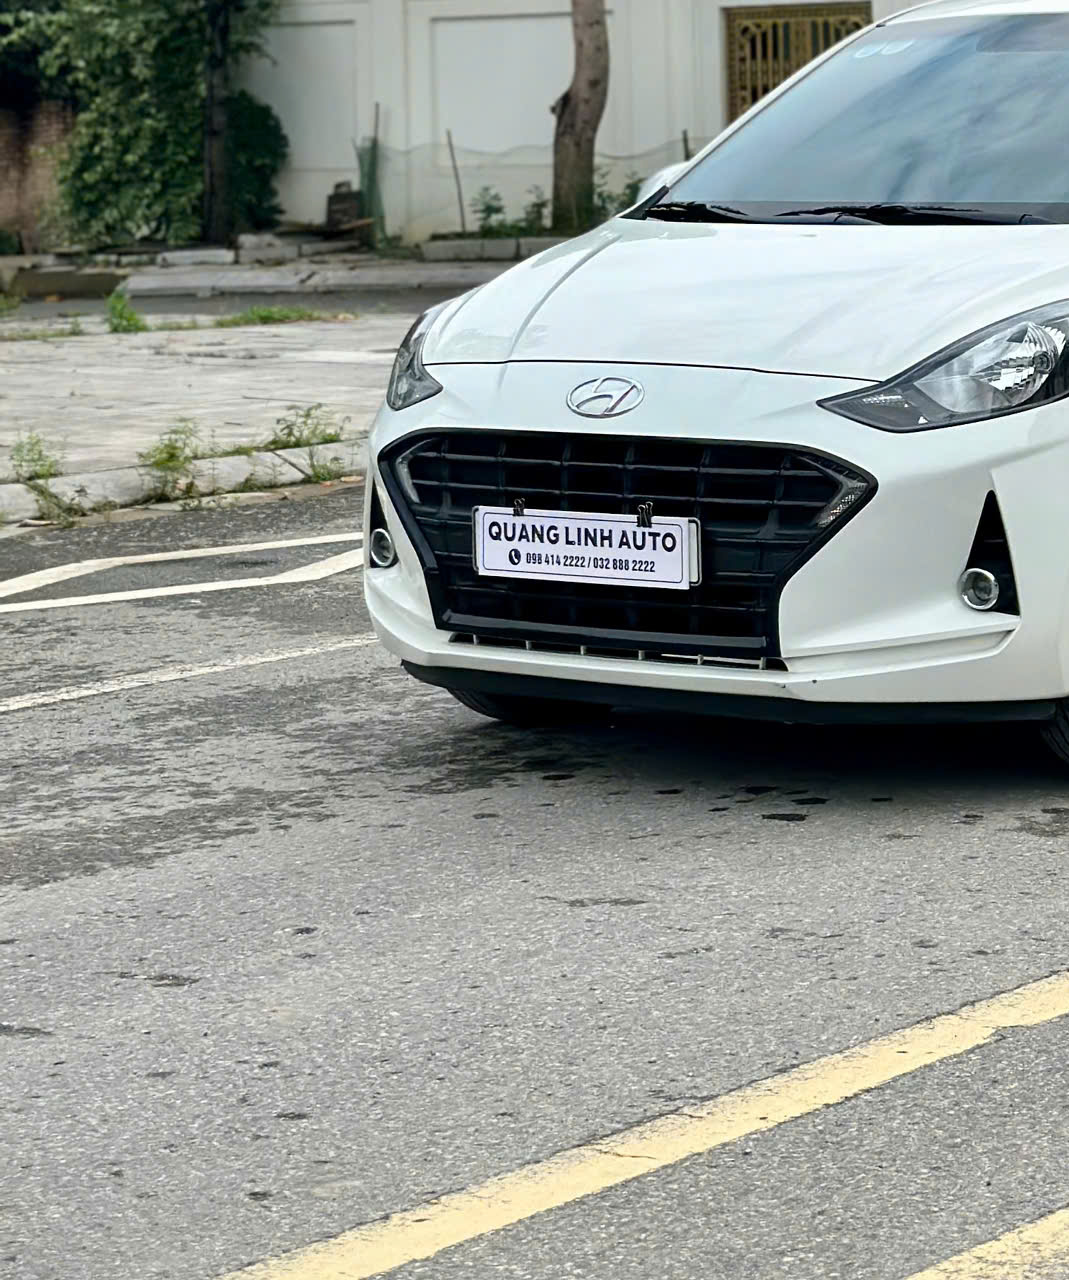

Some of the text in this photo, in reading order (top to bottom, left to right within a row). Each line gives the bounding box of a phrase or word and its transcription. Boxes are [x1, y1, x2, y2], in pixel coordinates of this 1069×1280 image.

[488, 521, 677, 552] QUANG LINH AUTO
[526, 552, 543, 565] 098
[544, 553, 561, 566] 414
[563, 556, 586, 568] 2222
[593, 557, 611, 570] 032
[612, 558, 630, 571] 888
[632, 560, 656, 573] 2222
